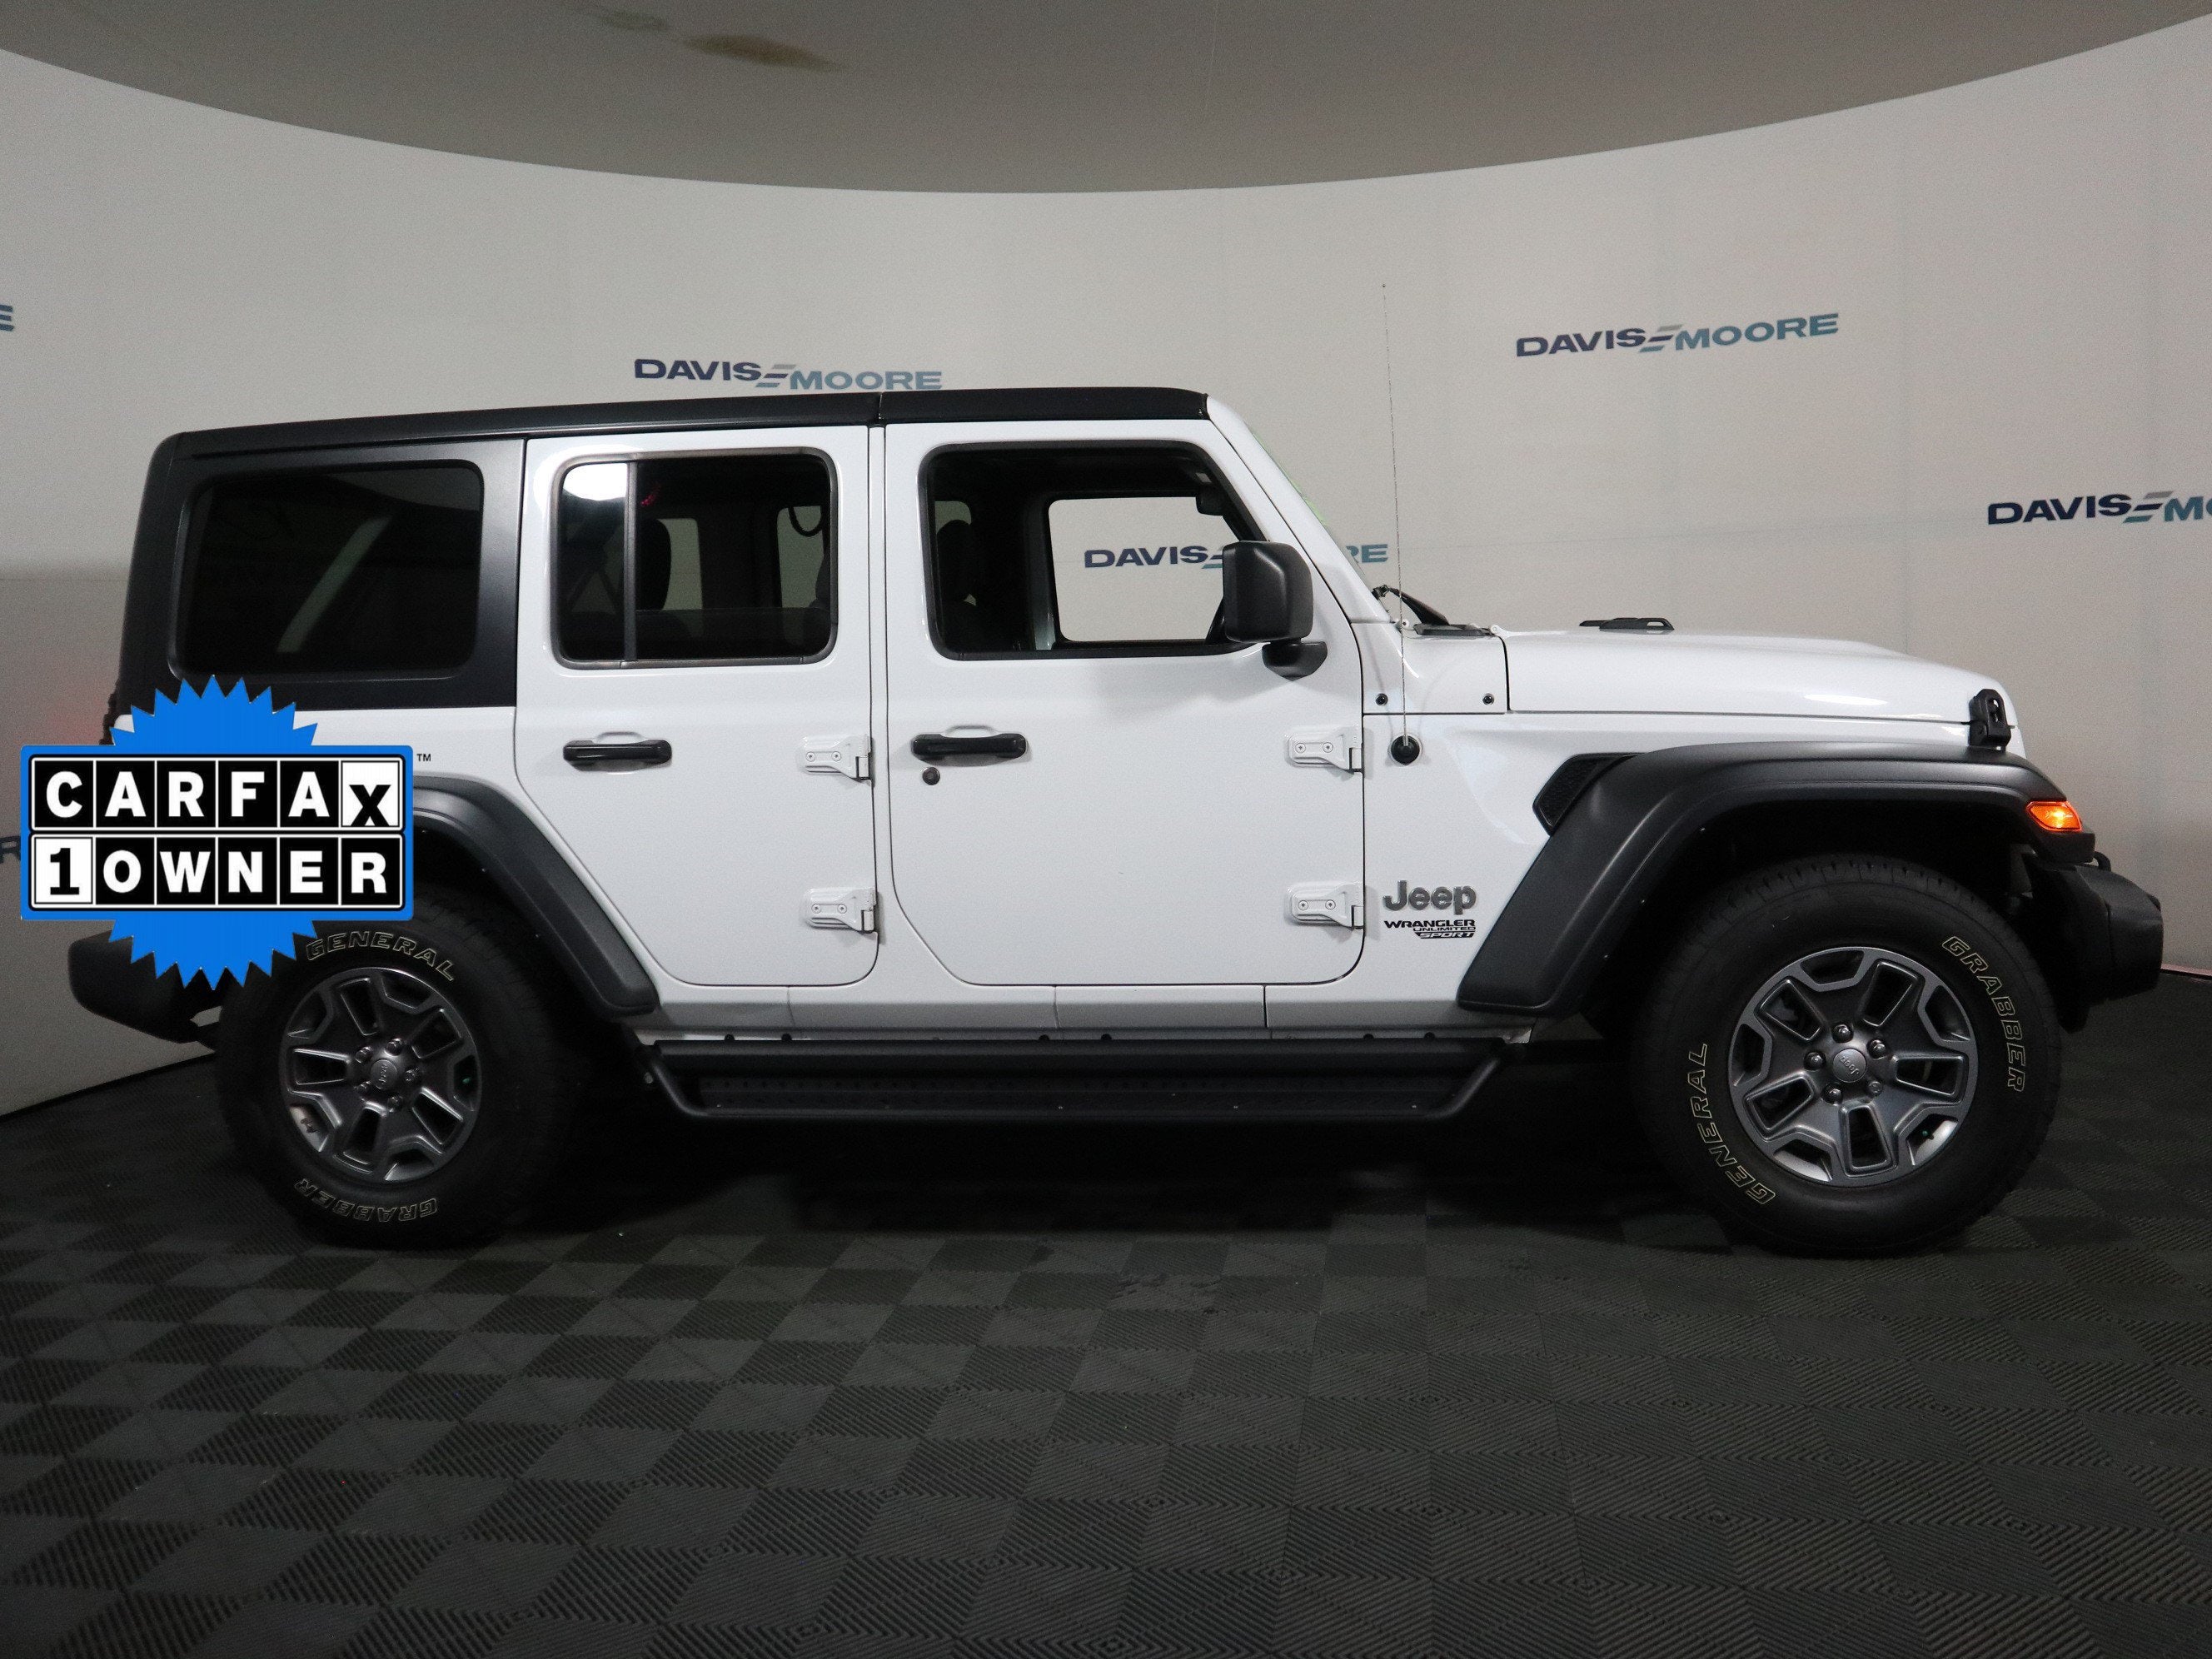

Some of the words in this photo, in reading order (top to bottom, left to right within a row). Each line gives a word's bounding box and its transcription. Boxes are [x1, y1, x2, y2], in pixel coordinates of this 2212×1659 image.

[1517, 328, 1647, 356] DAVIS
[1676, 313, 1839, 351] MOORE
[635, 358, 762, 381] DAVIS
[790, 370, 942, 390] MOORE
[1988, 494, 2132, 525] DAVIS
[2164, 496, 2212, 522] M
[1084, 546, 1208, 569] DAVIS
[1382, 879, 1477, 915] Jeep
[1383, 919, 1476, 929] WRANGLER
[306, 930, 455, 982] GENERAL
[1941, 935, 2026, 1093] GRABBER
[1687, 1043, 1776, 1205] GENERAL
[294, 1178, 437, 1223] GRABBER
